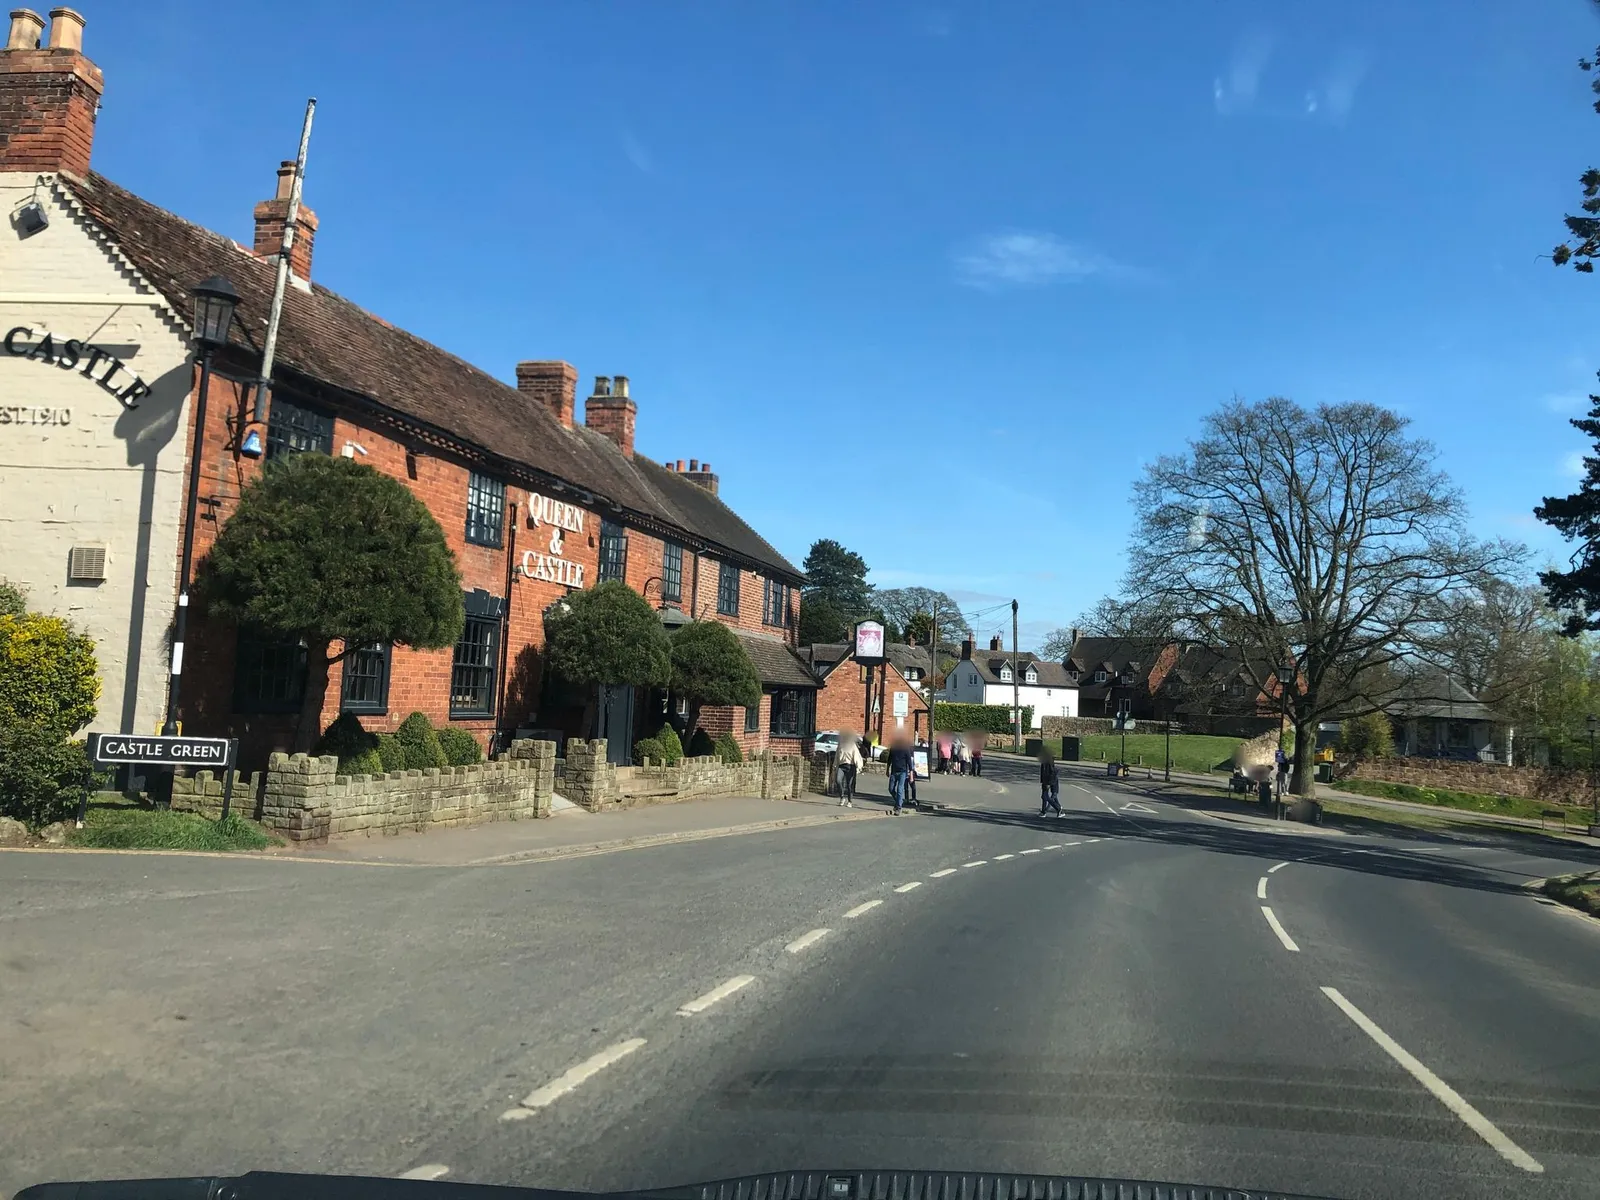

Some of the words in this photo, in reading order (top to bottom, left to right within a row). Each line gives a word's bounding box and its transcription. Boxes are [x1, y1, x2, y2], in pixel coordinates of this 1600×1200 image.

[4, 326, 152, 411] CASTLE
[31, 406, 72, 427] 1910
[529, 492, 585, 534] QUEEN
[549, 528, 564, 556] &
[522, 550, 584, 589] CASTLE
[105, 741, 163, 756] CASTLE
[170, 744, 221, 758] GREEN
